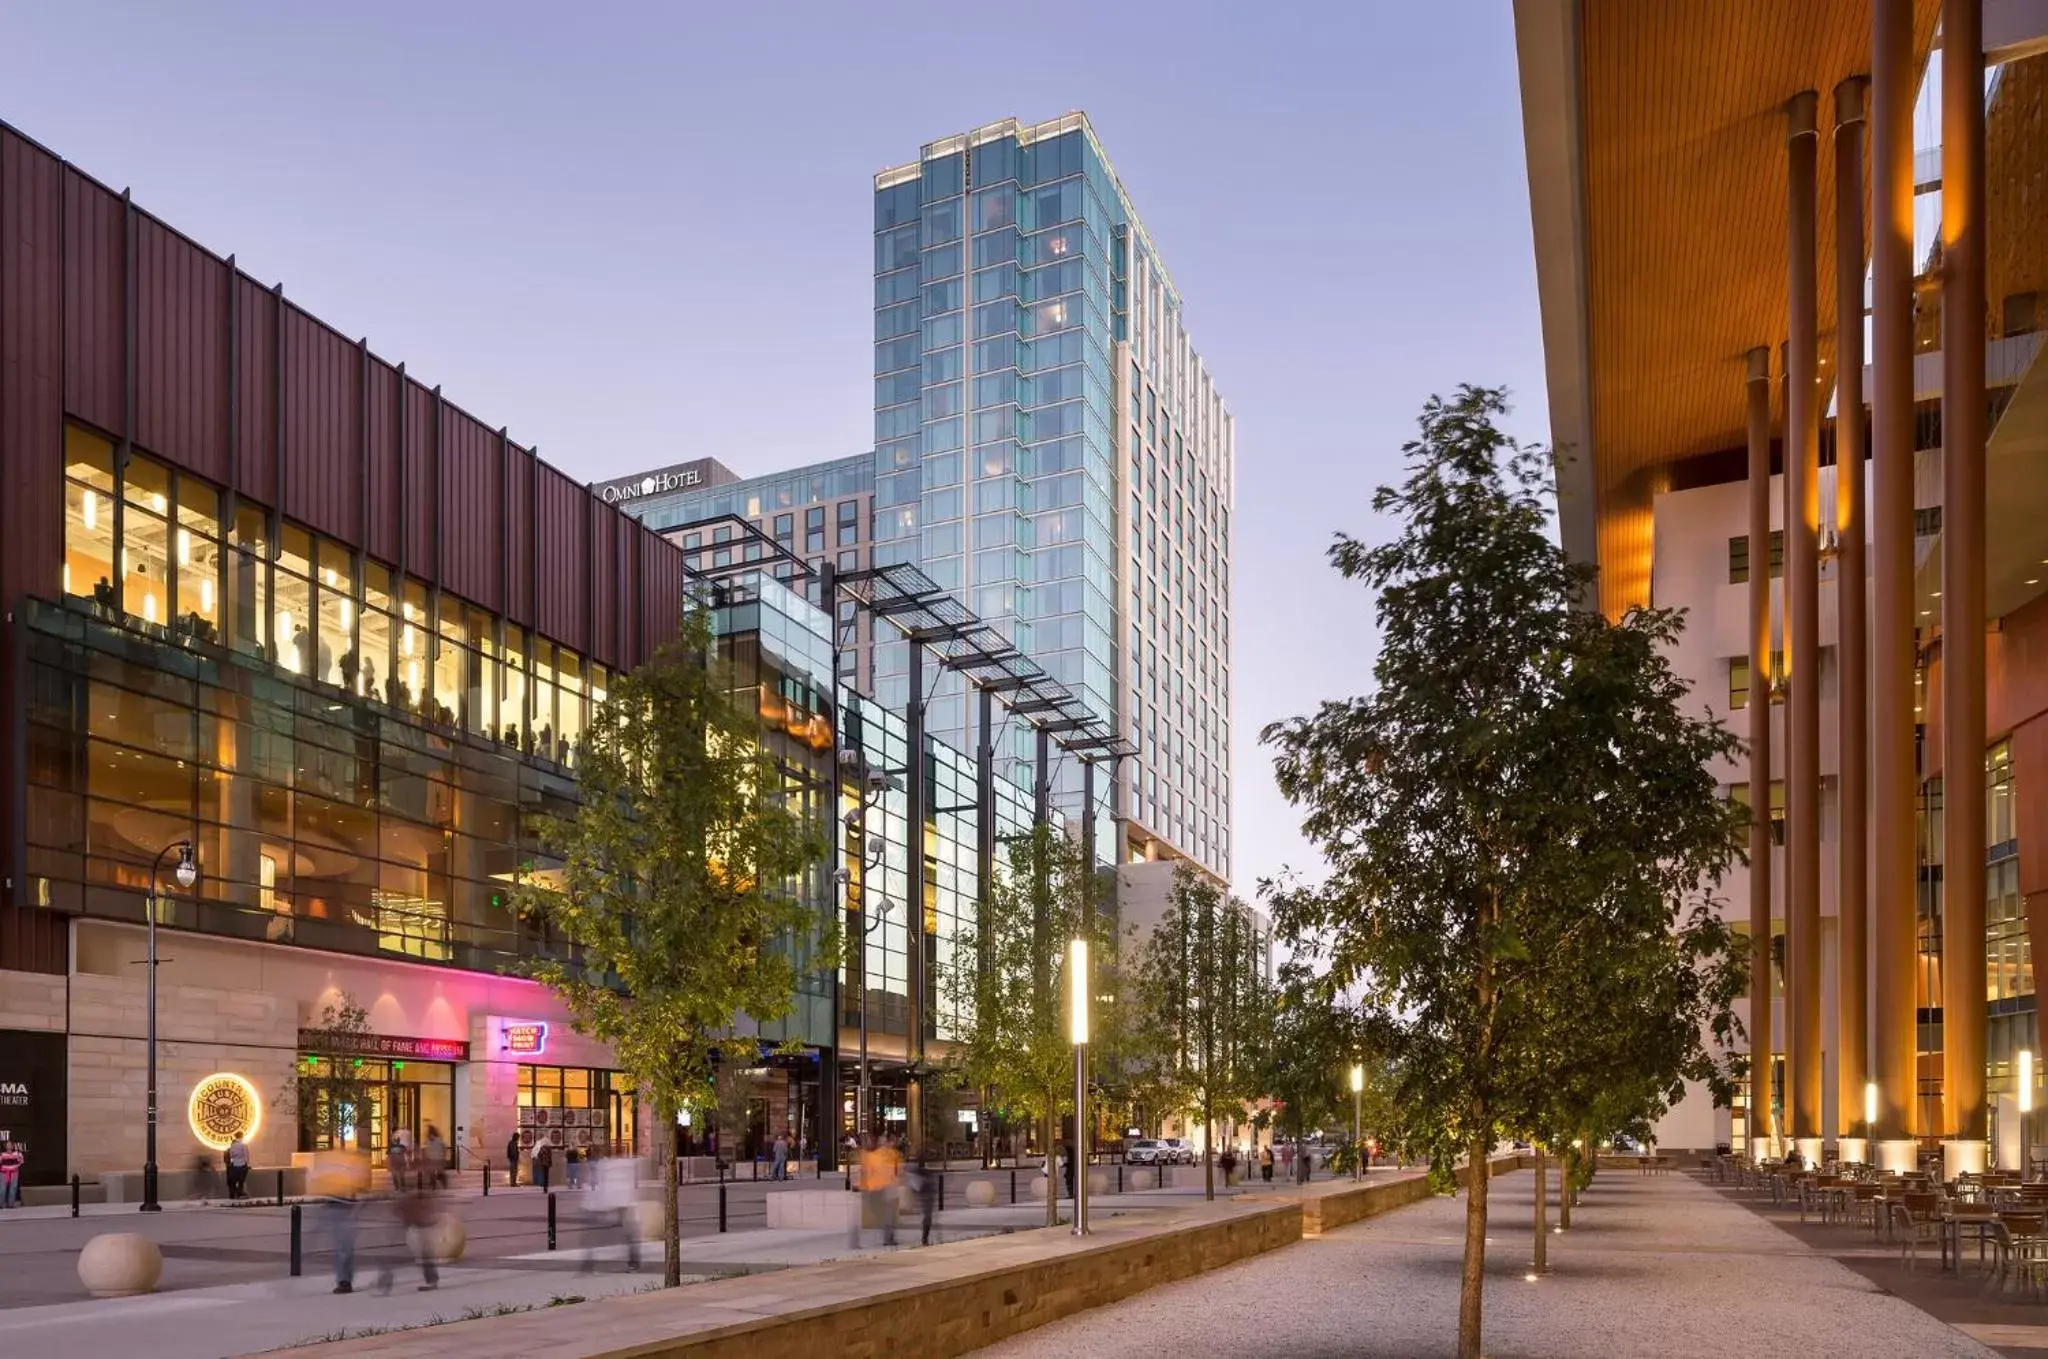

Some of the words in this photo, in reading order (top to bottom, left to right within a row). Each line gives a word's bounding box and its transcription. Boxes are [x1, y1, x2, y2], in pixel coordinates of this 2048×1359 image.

[603, 483, 641, 503] OMNI
[655, 470, 702, 493] HOTEL
[381, 1040, 392, 1052] OF
[393, 1041, 413, 1053] FAME
[0, 1083, 28, 1094] MA
[208, 1090, 240, 1104] MUSIC
